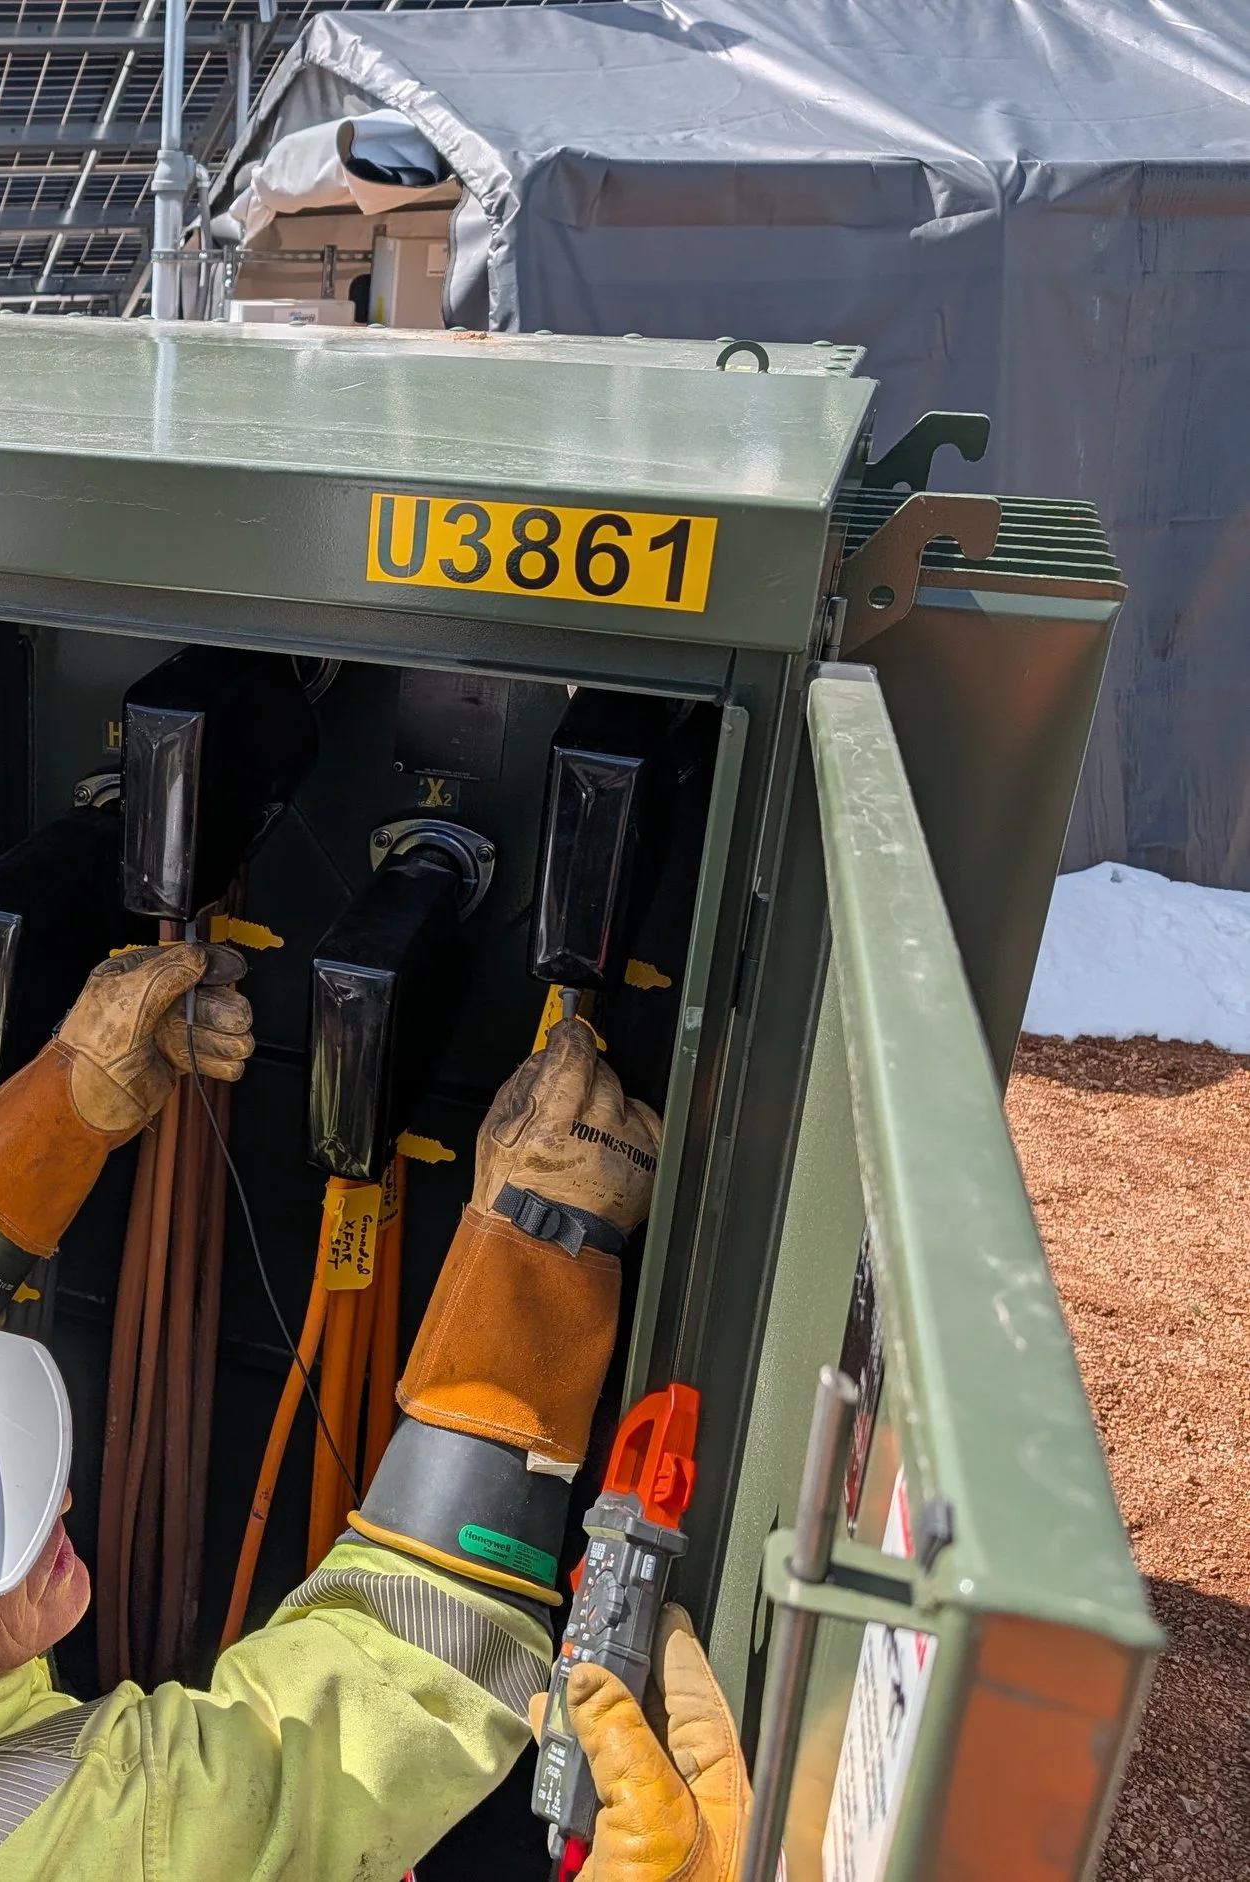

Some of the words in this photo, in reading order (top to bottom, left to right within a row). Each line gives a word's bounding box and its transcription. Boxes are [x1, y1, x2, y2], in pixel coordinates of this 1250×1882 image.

[377, 496, 692, 603] U3861
[339, 1219, 356, 1265] XFMR
[356, 1214, 373, 1276] Grounded
[464, 1529, 512, 1553] Honeywell
